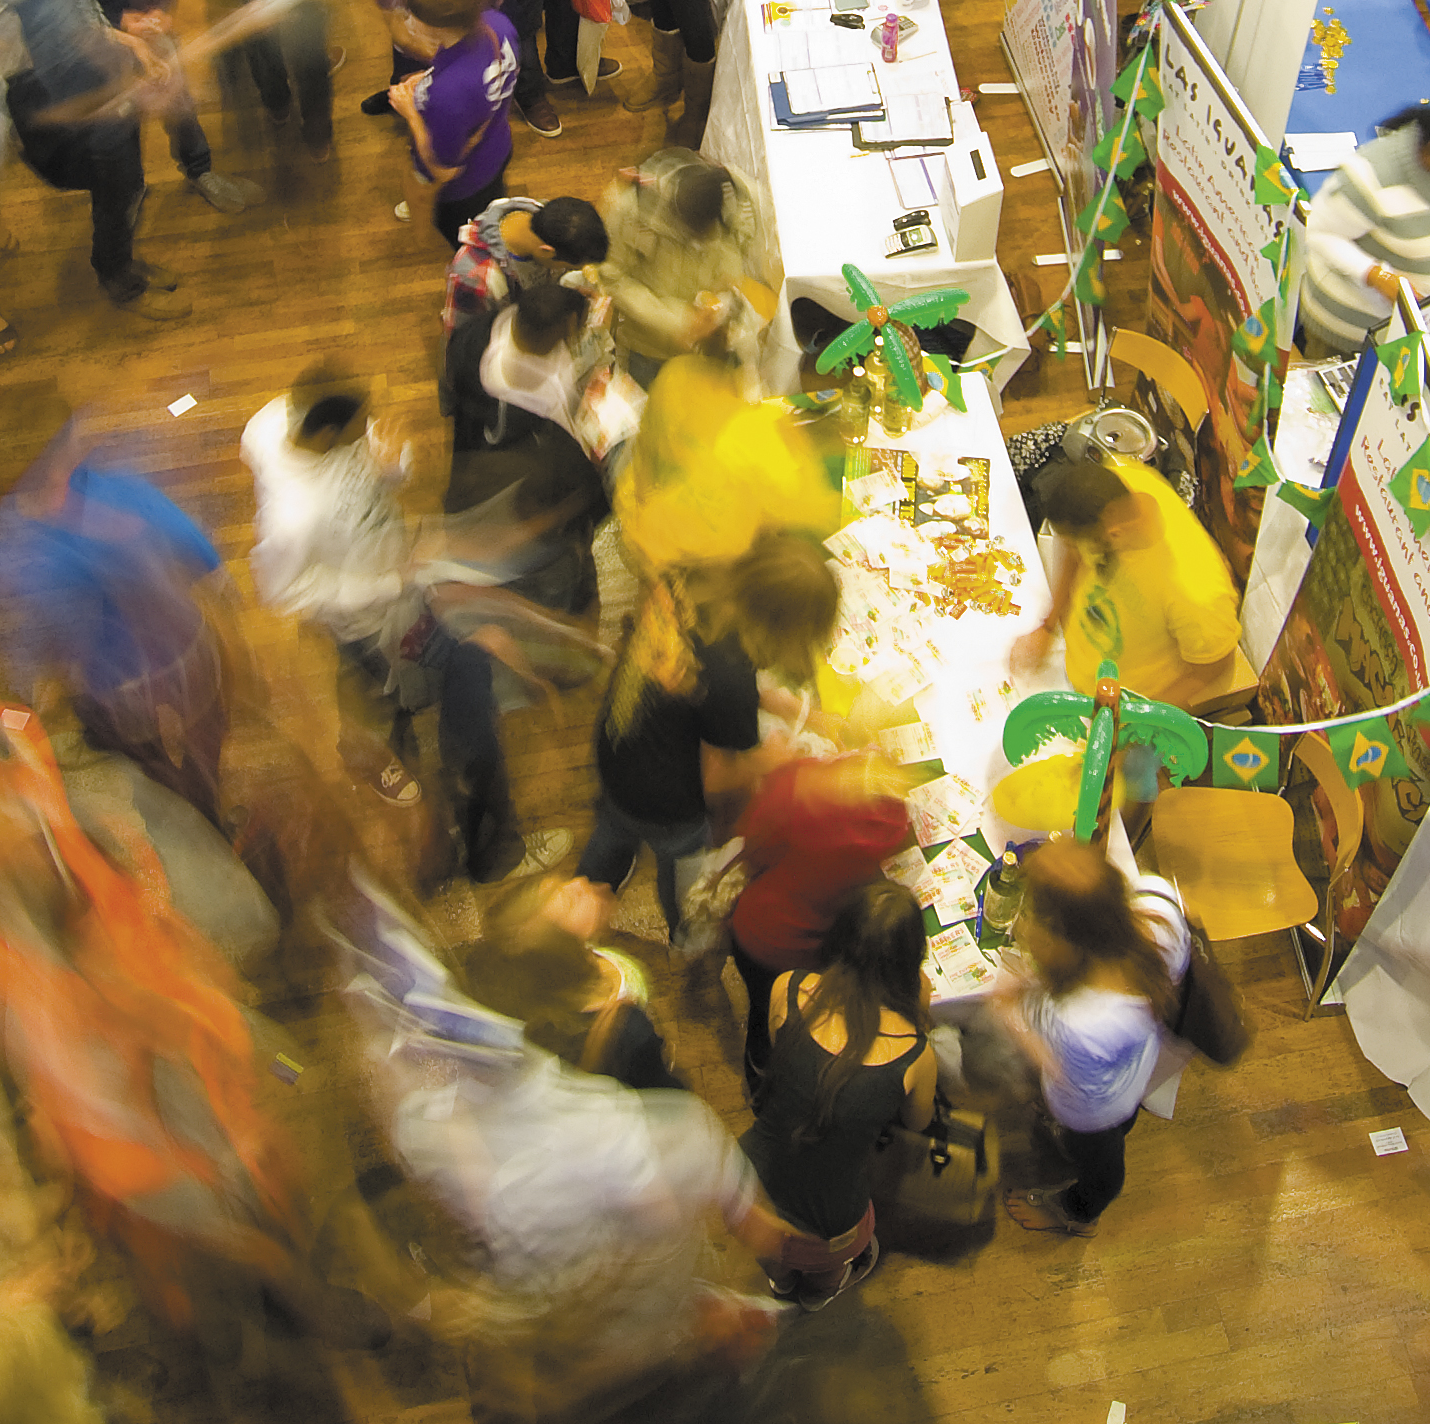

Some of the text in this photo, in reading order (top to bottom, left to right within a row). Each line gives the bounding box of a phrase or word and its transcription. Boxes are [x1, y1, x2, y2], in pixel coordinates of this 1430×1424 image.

[1165, 43, 1198, 102] LAS
[1163, 128, 1249, 266] Restaurant and
[1175, 125, 1206, 176] Latin
[1361, 434, 1415, 566] Restaurant
